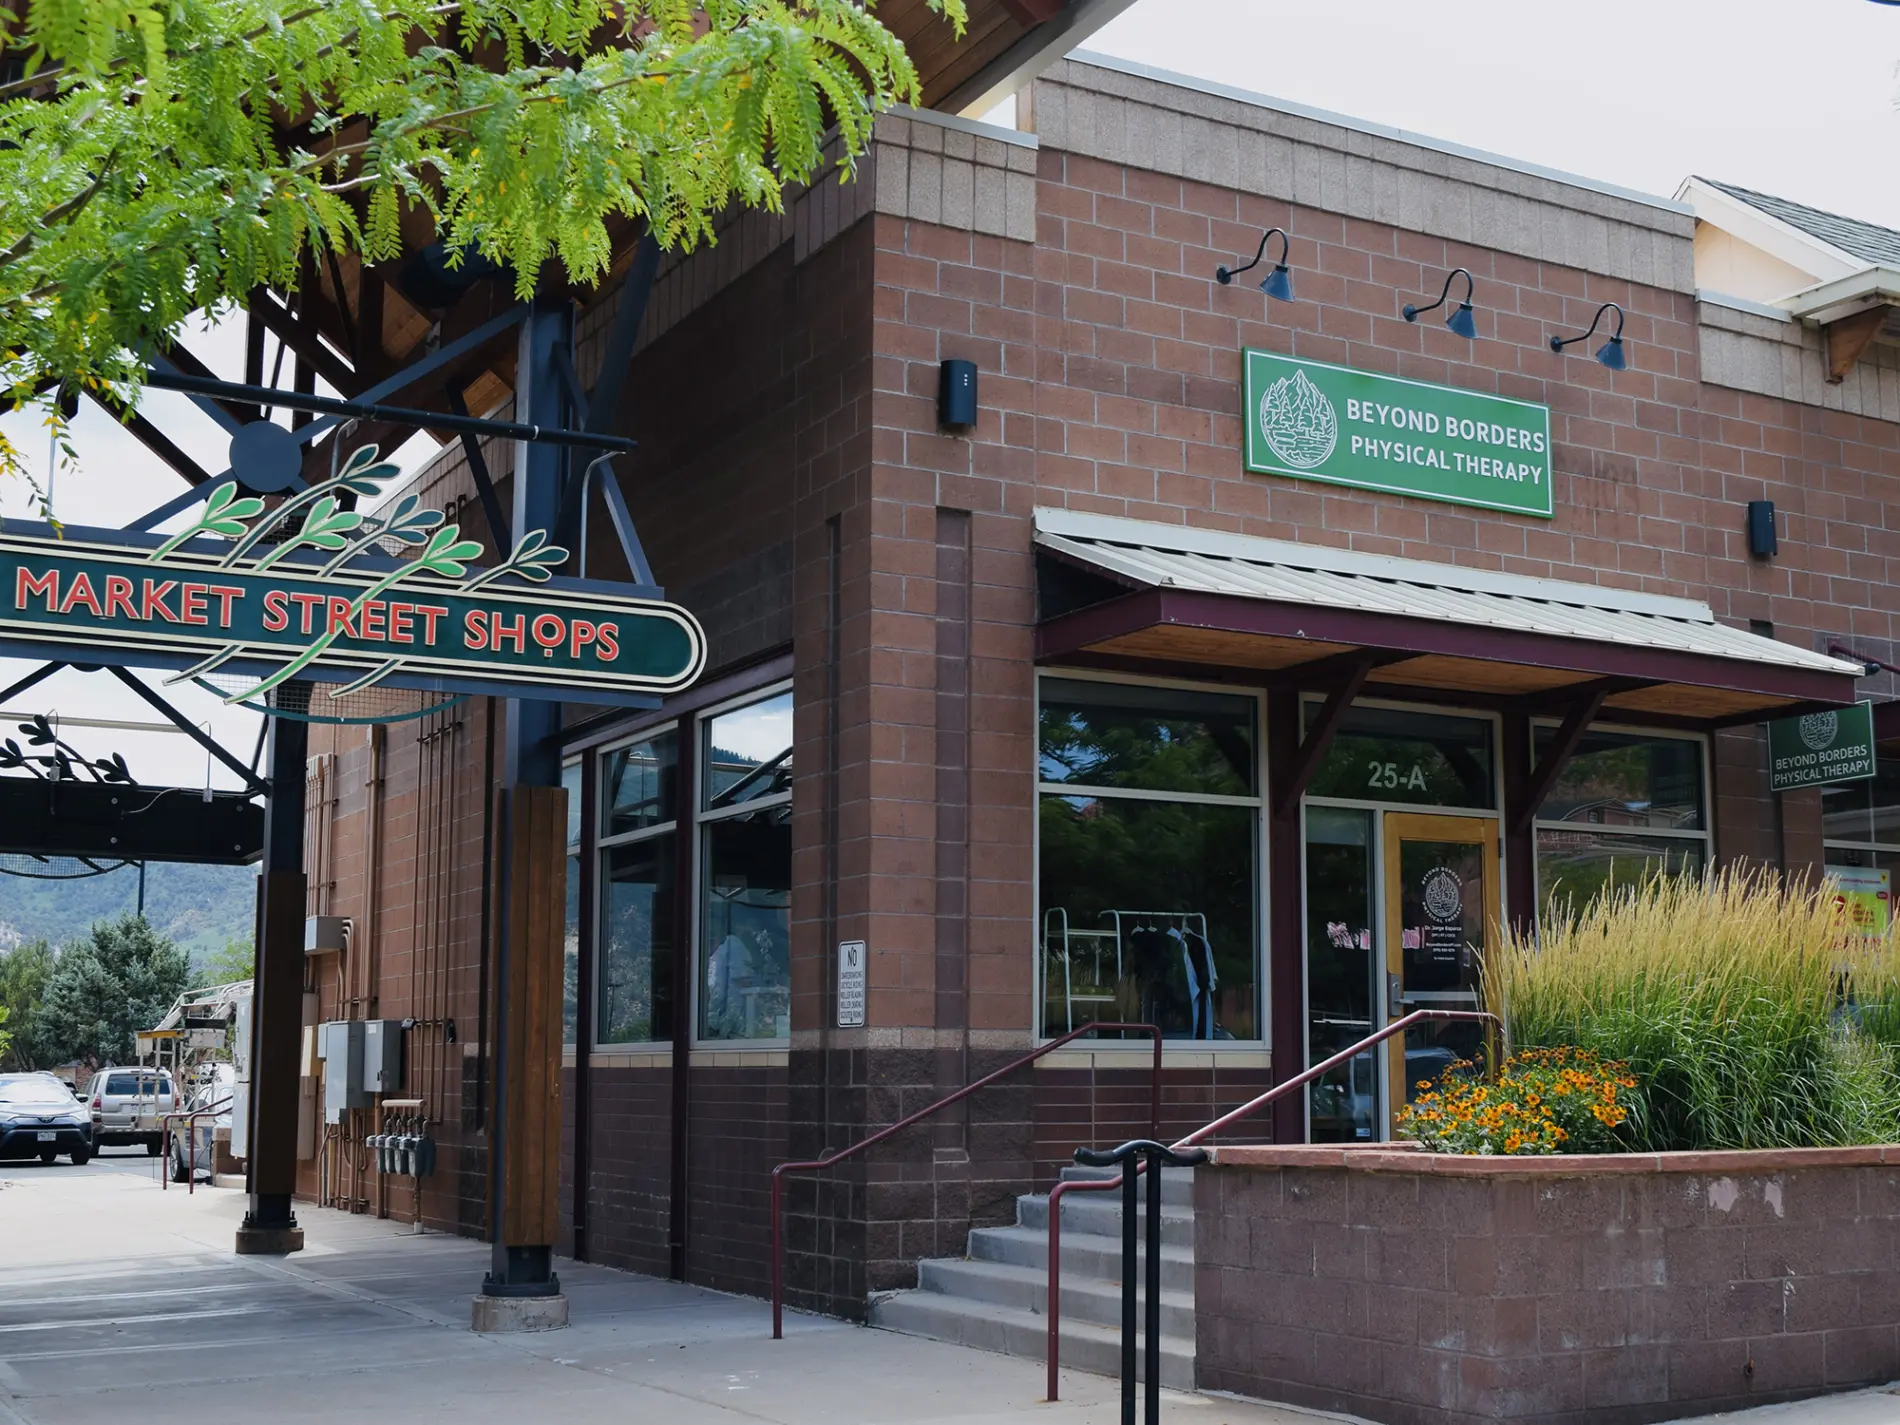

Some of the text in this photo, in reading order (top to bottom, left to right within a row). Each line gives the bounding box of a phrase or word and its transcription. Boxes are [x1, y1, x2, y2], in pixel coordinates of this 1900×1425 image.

[1347, 398, 1545, 453] BEYOND BORDERS
[1351, 435, 1542, 485] PHYSICAL THERAPY
[15, 566, 620, 662] MARKET STREET SHOPS
[1775, 744, 1868, 770] BEYOND BORDERS
[1368, 761, 1427, 791] 25-A
[1774, 759, 1870, 785] PHYSICAL THERAPY
[1421, 866, 1440, 885] BEYOND
[847, 949, 858, 967] NO
